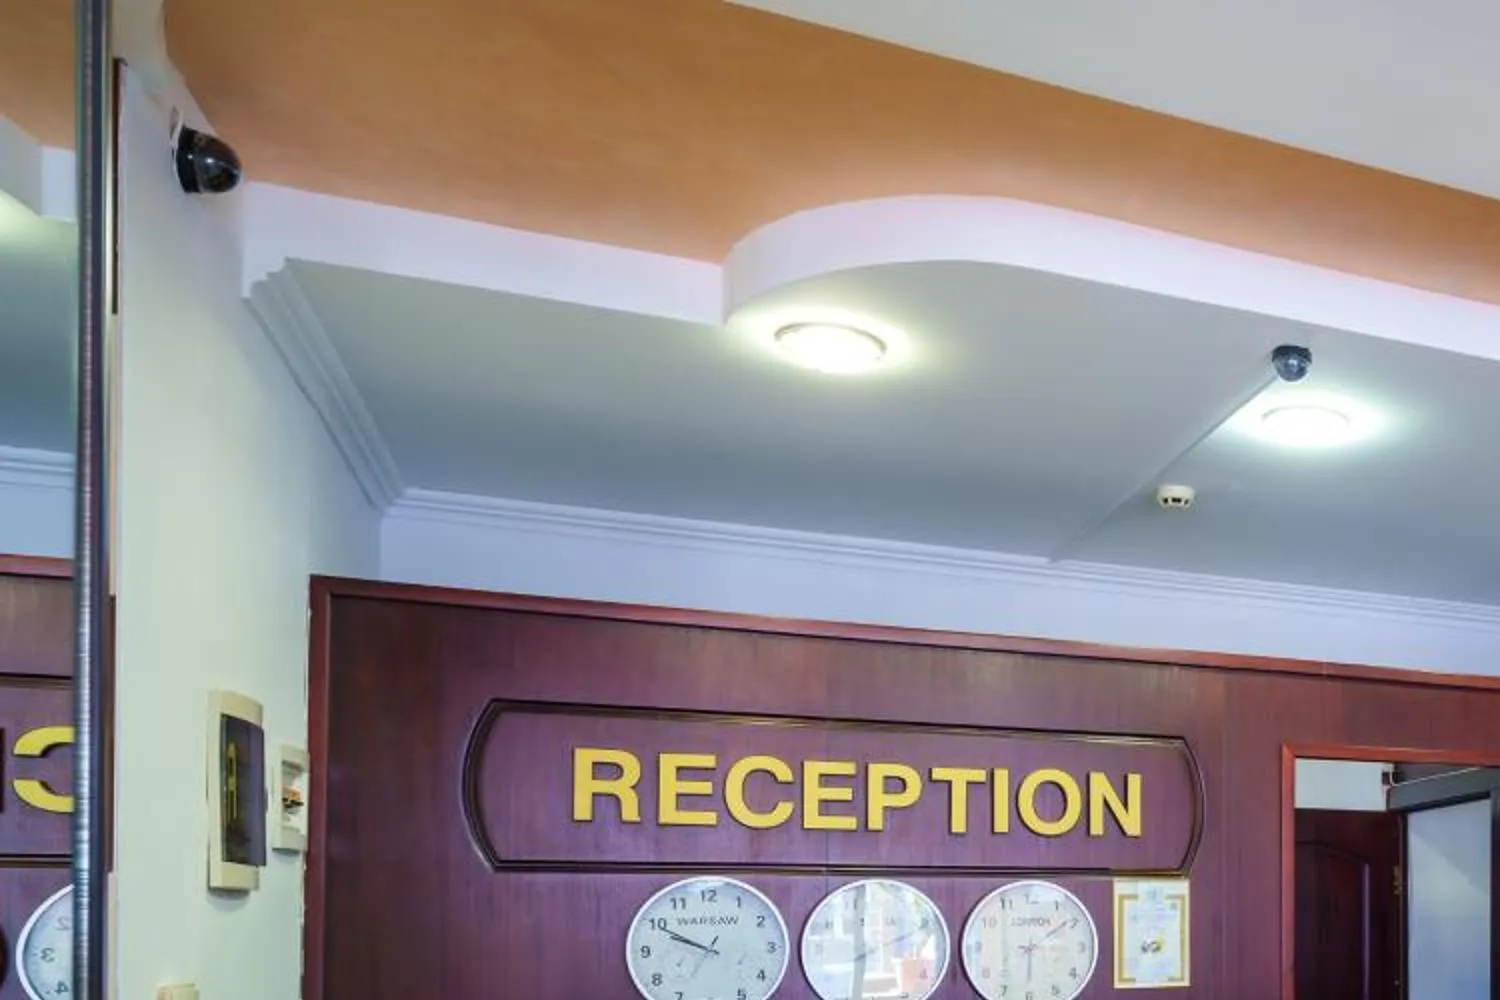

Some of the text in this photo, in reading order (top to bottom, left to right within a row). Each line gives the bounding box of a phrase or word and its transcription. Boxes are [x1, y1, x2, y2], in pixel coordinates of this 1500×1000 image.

[572, 746, 1142, 838] RECEPTION
[701, 889, 717, 902] 12
[736, 896, 742, 908] 1
[670, 897, 687, 910] 11
[1000, 897, 1013, 910] 11
[650, 918, 667, 930] 10
[677, 915, 740, 926] WARSAW
[756, 915, 765, 928] 2
[640, 945, 651, 958] 9
[767, 941, 777, 953] 3
[651, 973, 663, 986] 8
[756, 969, 766, 981] 4
[1069, 967, 1077, 980] 4
[737, 988, 747, 1000] 5
